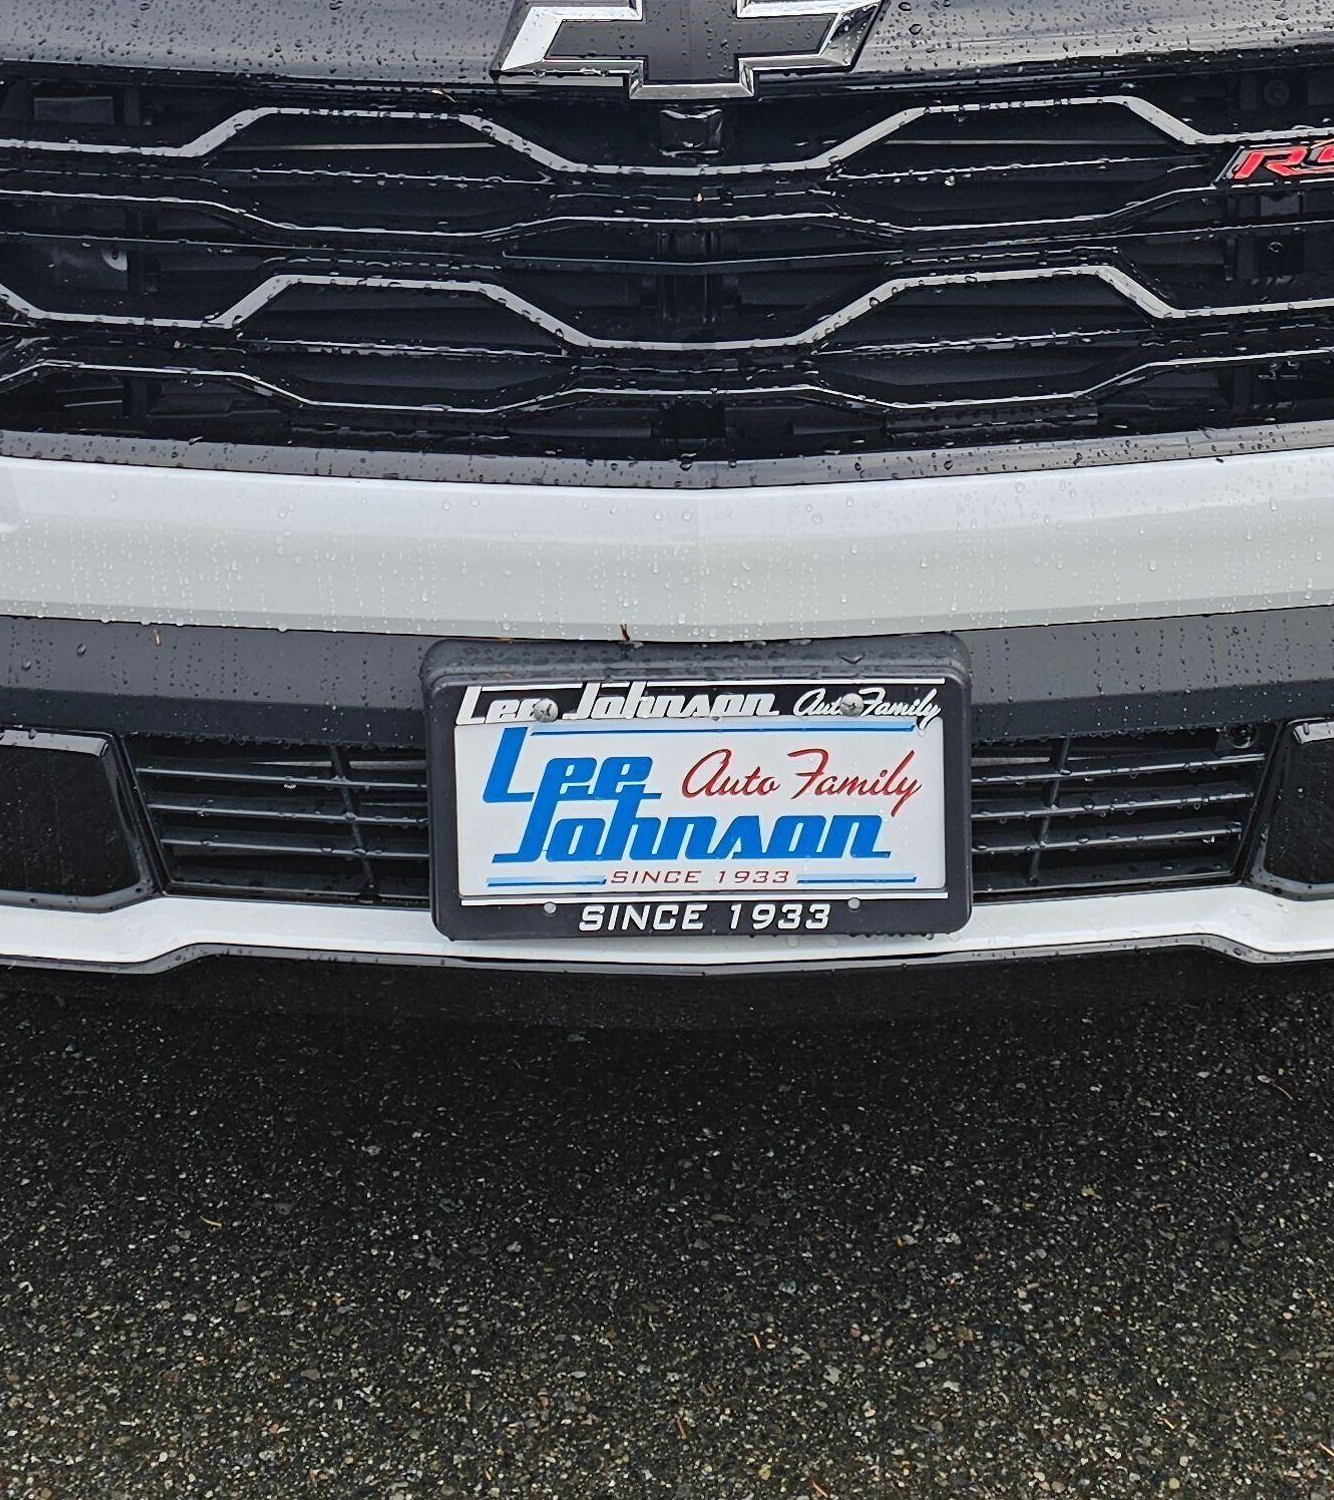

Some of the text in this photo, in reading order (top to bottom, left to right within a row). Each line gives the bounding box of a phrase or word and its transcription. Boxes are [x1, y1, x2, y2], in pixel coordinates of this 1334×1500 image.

[562, 681, 780, 722] Johnson
[858, 687, 942, 731] Family
[482, 727, 662, 803] Lee
[681, 748, 924, 817] Auto Family
[491, 794, 892, 864] Johnson
[610, 869, 792, 885] SINCE 1933
[578, 902, 832, 932] SINCE 1933
